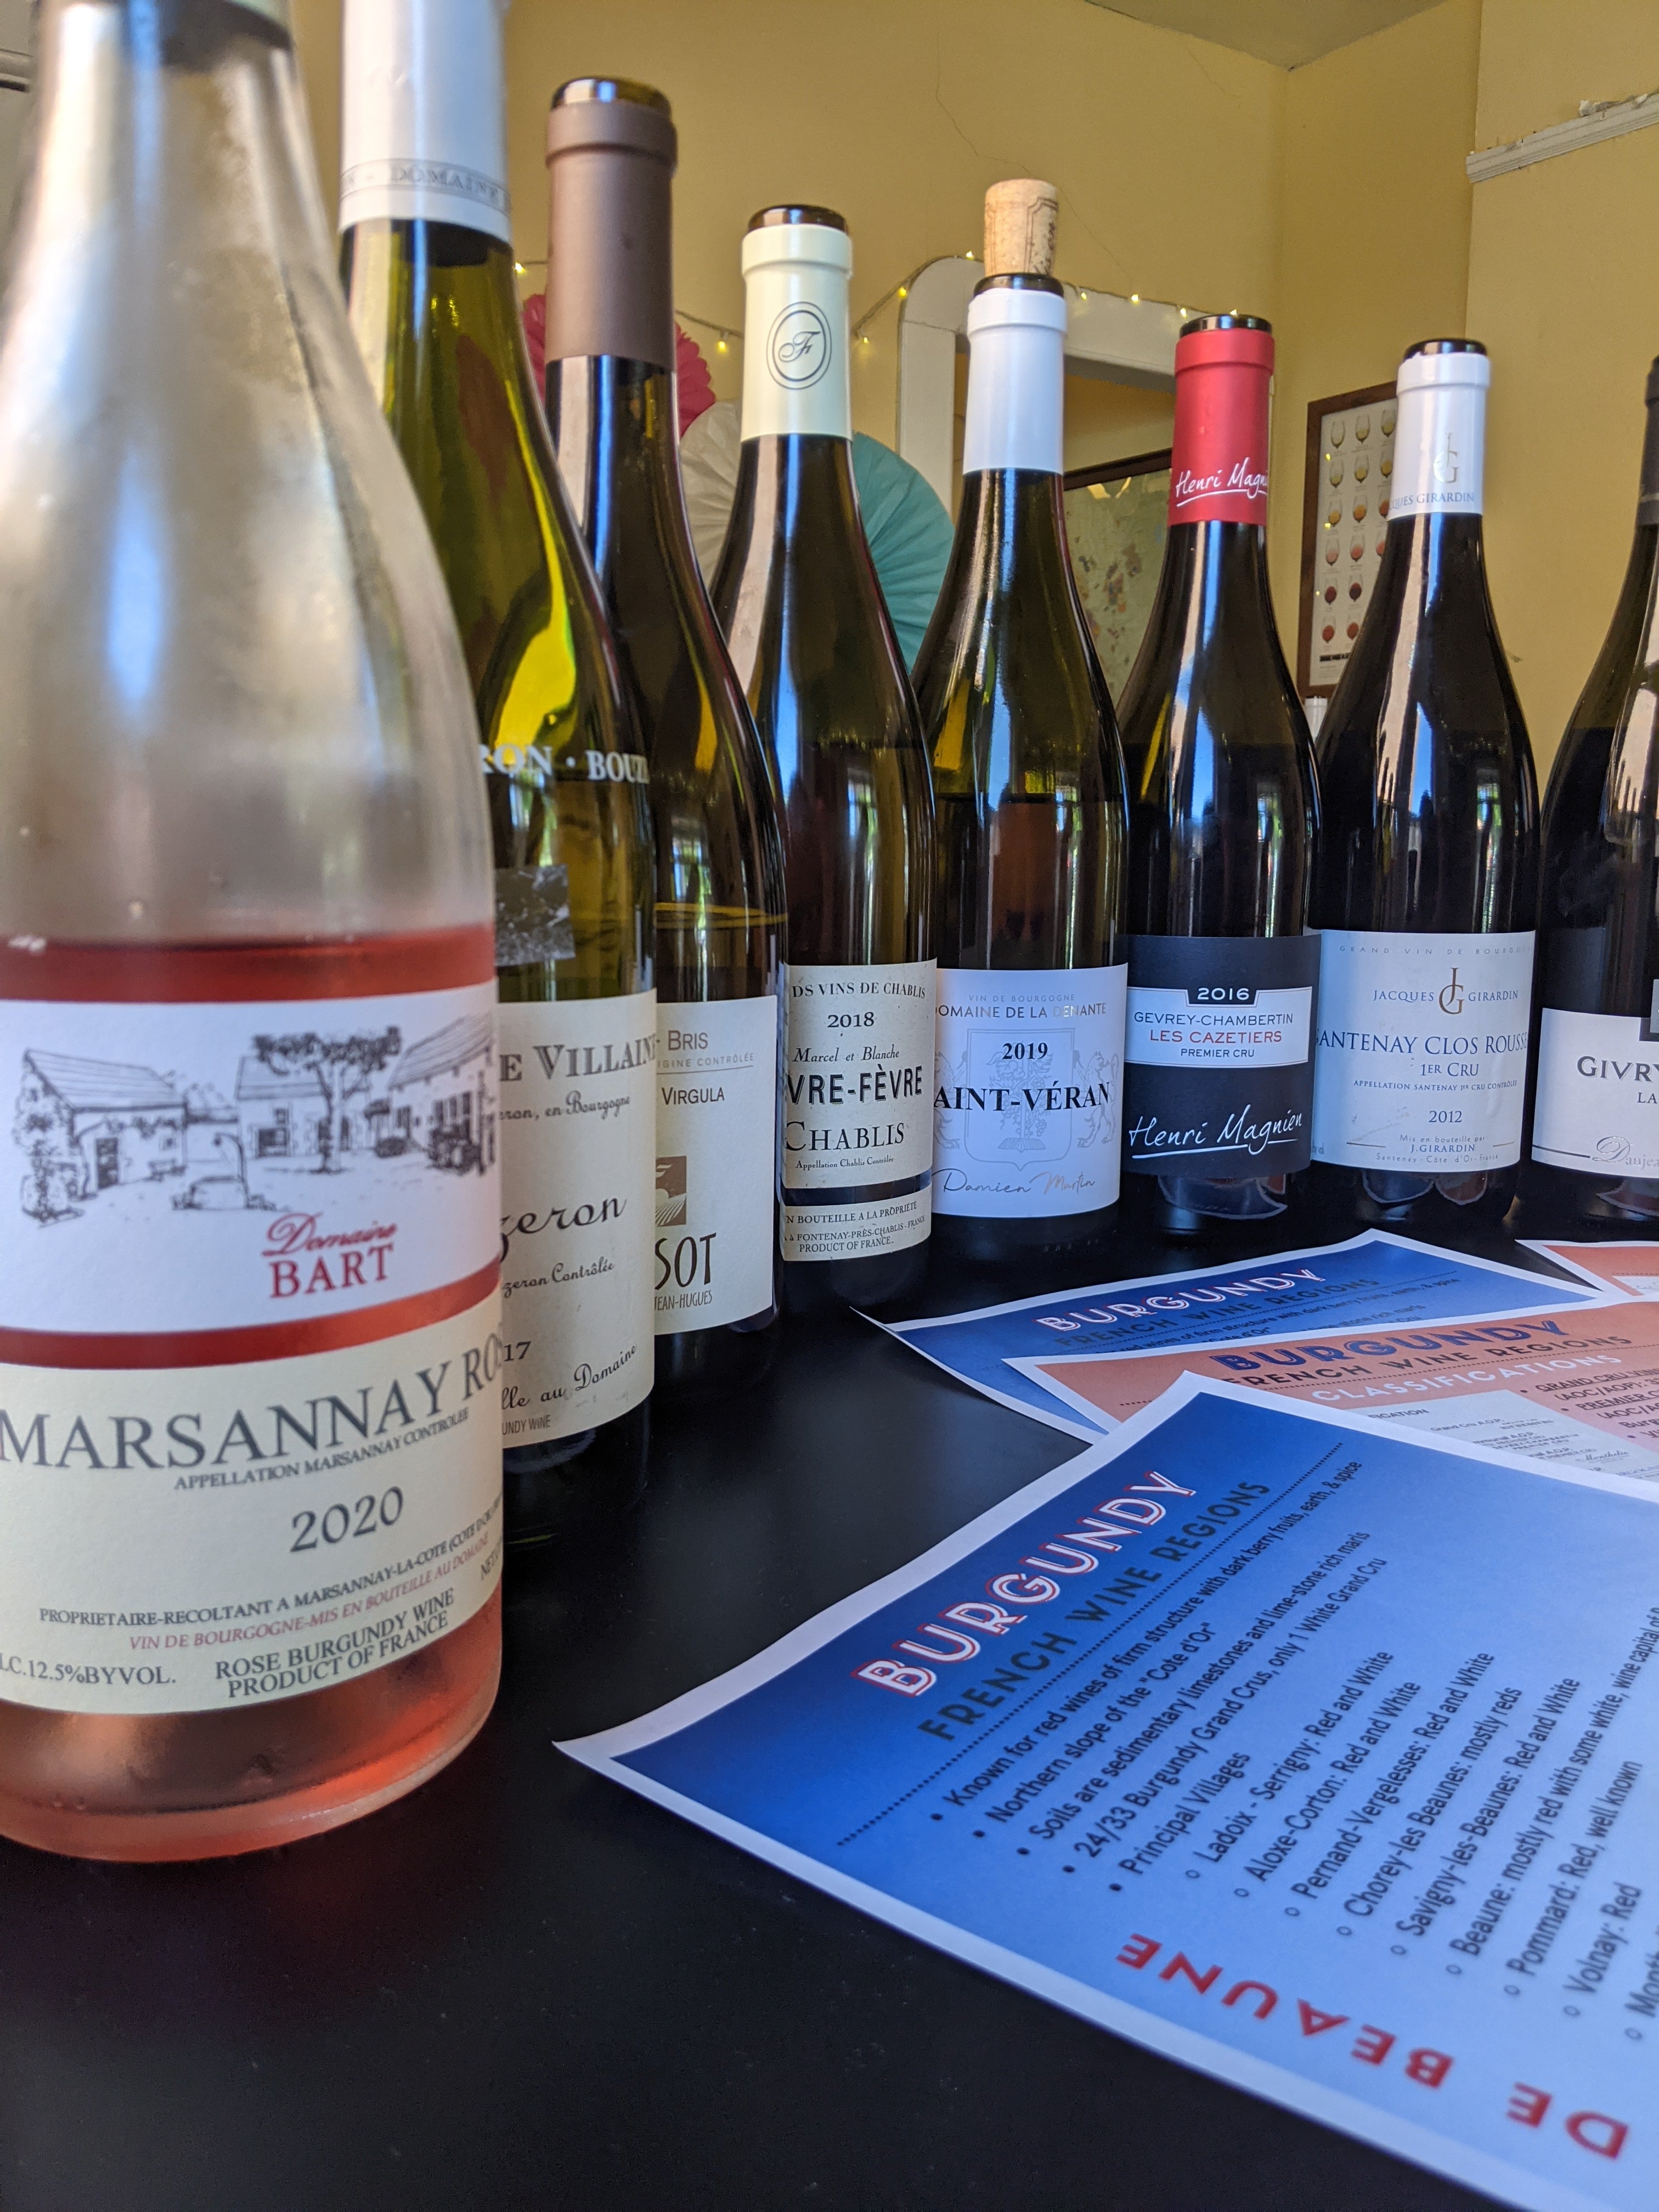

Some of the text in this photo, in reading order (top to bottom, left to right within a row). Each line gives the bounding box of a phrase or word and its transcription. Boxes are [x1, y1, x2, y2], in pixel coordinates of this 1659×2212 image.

[1417, 492, 1474, 504] GIRARDIN
[1340, 945, 1389, 954] GRAND
[792, 981, 926, 999] DS VINS DE CHABLIS
[1006, 1002, 1107, 1019] DE LA DENANTE
[1011, 994, 1075, 1002] BOURGOGNE
[1197, 988, 1250, 1001] 2016
[1374, 989, 1519, 1003] JACQUES GIRARDIN
[827, 1011, 875, 1028] 2018
[1133, 1011, 1294, 1026] GEVREY-CHAMBERTIN
[1150, 1029, 1282, 1044] LES CAZETIERS
[668, 1030, 709, 1051] BRIS
[696, 1052, 754, 1067] CONTRÔLÉE
[792, 1043, 900, 1063] Marcel et Blanche
[1002, 1042, 1048, 1060] 2019
[1181, 1048, 1255, 1058] PREMIER CRU
[1424, 1036, 1479, 1055] CLOS
[787, 1063, 923, 1105] VRE-FÈVRE
[1353, 1079, 1486, 1091] APPELLATION SANTENAY CRU
[1420, 1062, 1479, 1077] 1ER CRU
[565, 1090, 630, 1120] Bourgogne
[662, 1086, 725, 1106] VIRGULA
[933, 1080, 1110, 1112] AINT-VÉRAN
[1637, 1092, 1658, 1104] LA
[786, 1121, 905, 1152] CHABLIS
[1128, 1103, 1303, 1156] Henri Magnien
[1428, 1110, 1463, 1124] 2012
[1410, 1144, 1476, 1154] J.GIRARDIN
[1435, 1135, 1471, 1143] bouteille
[795, 1154, 894, 1171] Appellation Chablis Contrôlée
[931, 1168, 1096, 1195] Damien Martin
[797, 1201, 917, 1224] BOUTEILLE LA PROPRIÉTÉ
[797, 1223, 904, 1242] FONTENAY-PRÈS-CHABLIS
[261, 1211, 398, 1257] Domaine
[799, 1241, 859, 1252] PRODUCT OF
[269, 1242, 394, 1299] BART
[502, 1256, 615, 1297] zeron Contrôlée
[654, 1232, 717, 1291] SOT
[1032, 1268, 1325, 1333] BURGUNDY
[1053, 1277, 1380, 1347] FRENCH WINE REGIONS
[503, 1340, 532, 1362] 17
[1209, 1319, 1570, 1370] BURGUNDY
[1222, 1335, 1633, 1386] FRENCH WINE REGIONS
[540, 1344, 637, 1403] au Domaine
[1312, 1354, 1623, 1402] CLASSIFICATIONS
[1535, 1376, 1594, 1392] GRAND
[0, 1360, 453, 1470] MARSANNAY
[1575, 1393, 1647, 1411] PREMIER
[174, 1434, 403, 1491] APPELLATION MARSANNAY
[289, 1486, 405, 1554] 2020
[39, 1599, 274, 1627] PROPRIETAIRE-RECOLTANT
[294, 1540, 447, 1615] MARSANNAY-LA-COTE
[849, 1470, 1197, 1698] BURGUNDY
[129, 1601, 363, 1651] VIN DE BOURGOGNE-MIS EN
[917, 1482, 1271, 1741] FRENCH WINE REGIONS
[215, 1588, 455, 1680] ROSE BURGUNDY WINE
[228, 1610, 449, 1699] PRODUCT OF FRANCE
[943, 1461, 1362, 1807] Known wines firm structure with dark berry fruits, earth, spice
[1028, 1531, 1370, 1839] Soils sedimentary limestones lime-stone rich marls
[984, 1622, 1216, 1823] Northern slope "Cote d'Or"
[1073, 1573, 1370, 1859] 24/33 Burgundy Grand Crus, only White Grand
[1192, 1650, 1394, 1863] Ladoix Serrigny: White
[1291, 1652, 1496, 1899] Pernand-Vergelesses: White
[1244, 1680, 1422, 1882] Aloxe-Corton: White
[1343, 1686, 1523, 1916] Chorey-les Beaunes: mostly reds
[1118, 1752, 1251, 1875] Principal Villages
[1395, 1678, 1581, 1937] Savigny-les-Beaunes: White
[1448, 1662, 1641, 1957] Beaune: mostly with some white, wine
[1505, 1760, 1644, 1977] Pommard: Red, well known
[1562, 1922, 1629, 1994] Volnay:
[1115, 1933, 1630, 2161] DE BEAUNE
